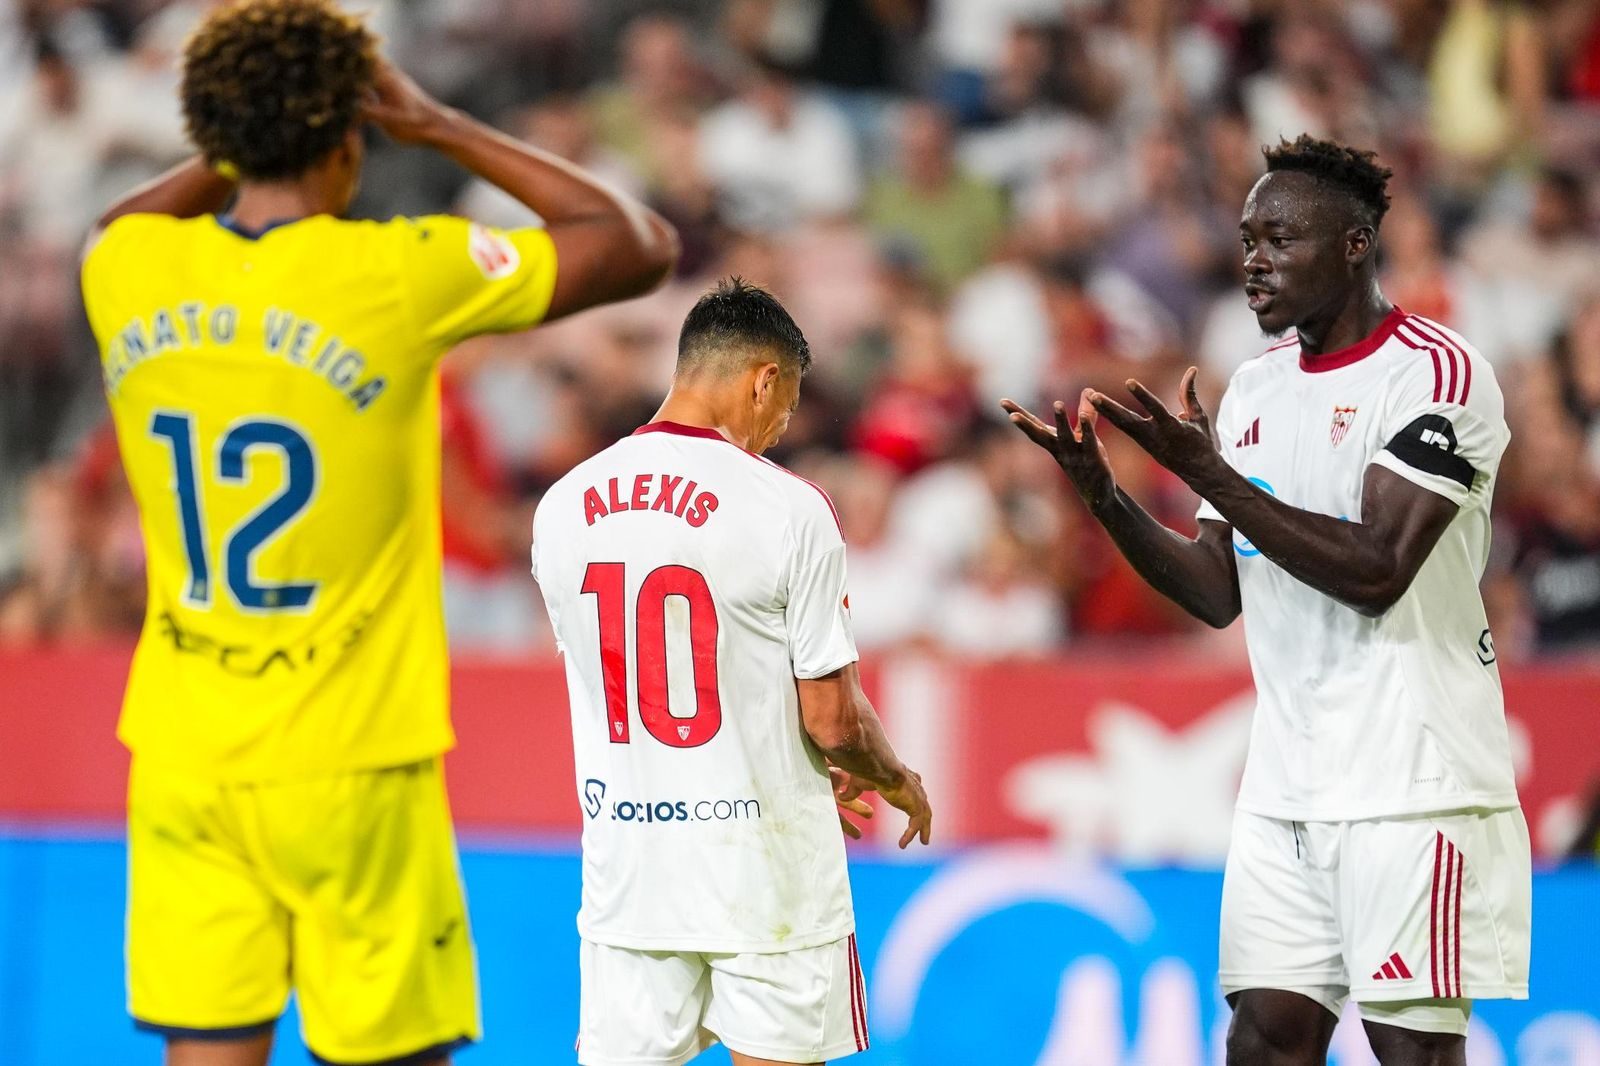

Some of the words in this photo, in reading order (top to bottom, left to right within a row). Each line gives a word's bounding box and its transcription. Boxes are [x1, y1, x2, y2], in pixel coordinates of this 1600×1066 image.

[264, 309, 386, 412] VEIGA
[149, 411, 320, 615] 12
[583, 473, 719, 528] ALEXIS
[580, 562, 721, 748] 10
